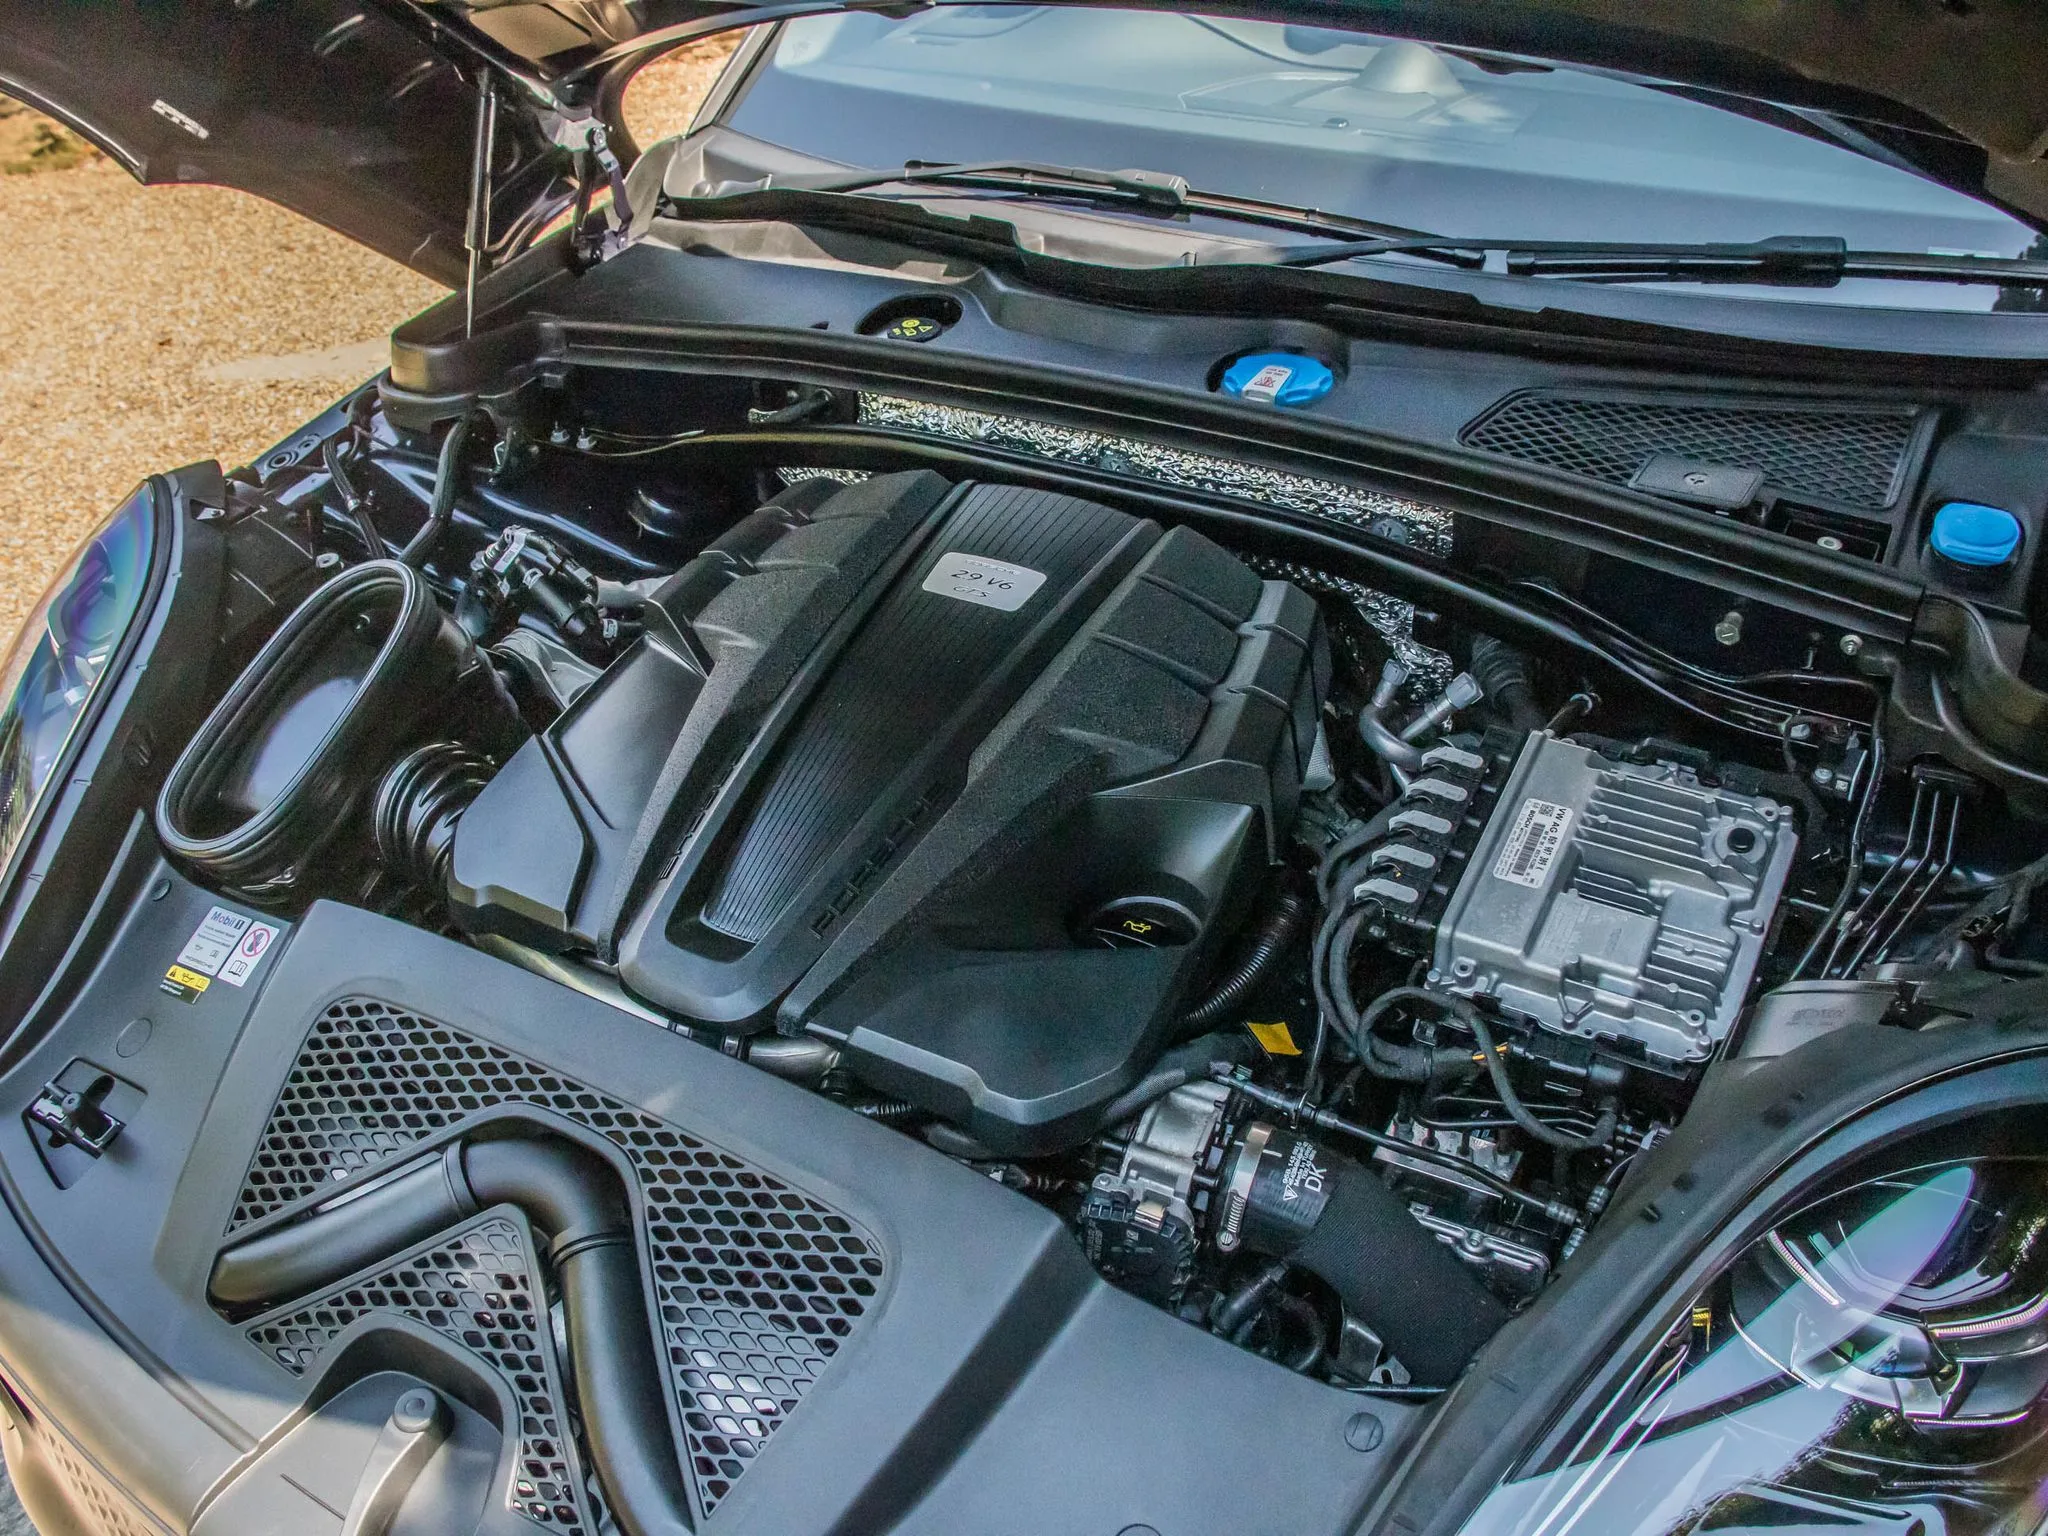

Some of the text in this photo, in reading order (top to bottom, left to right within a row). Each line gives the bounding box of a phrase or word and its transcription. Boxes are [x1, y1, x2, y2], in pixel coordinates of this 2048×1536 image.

[987, 577, 1014, 590] V6
[1523, 809, 1536, 829] BOSCH
[1555, 808, 1567, 821] VW
[1549, 821, 1560, 834] AG
[210, 911, 237, 927] Mobil
[1304, 1162, 1327, 1192] DK
